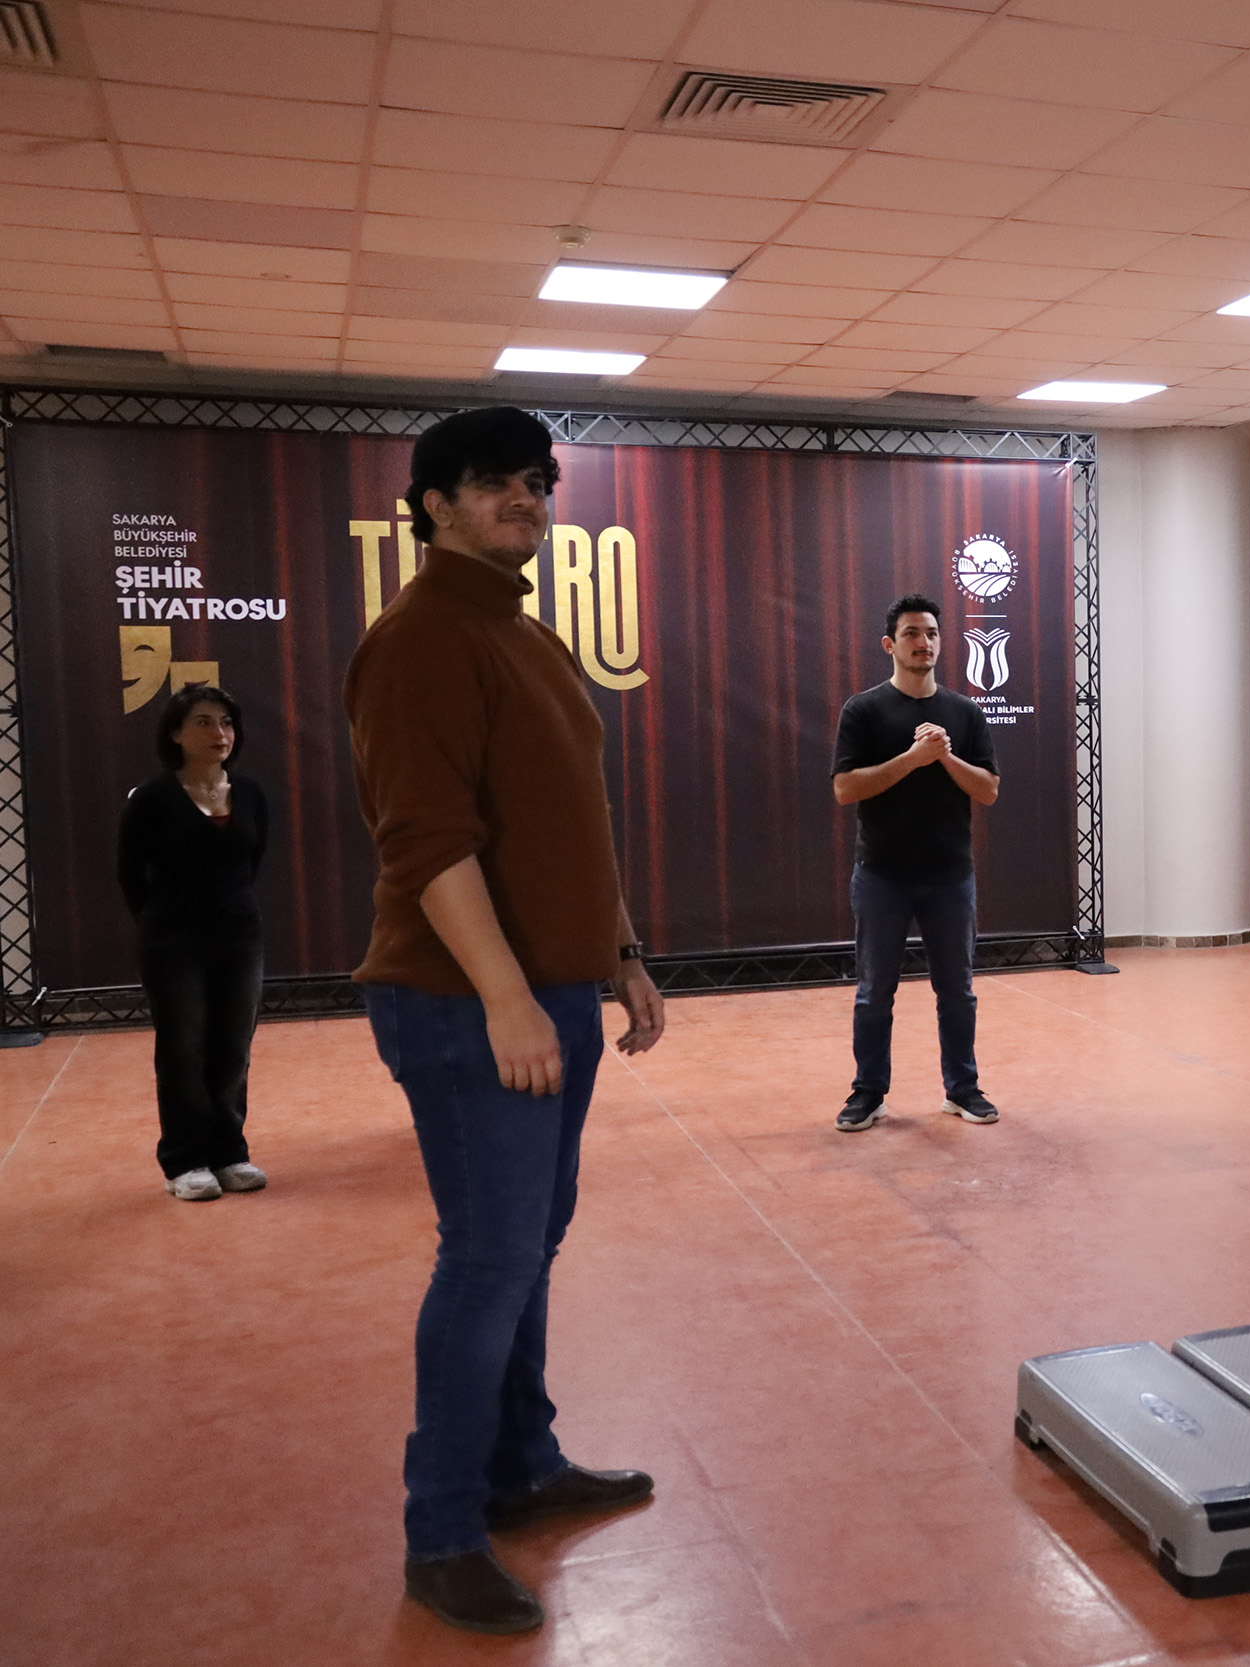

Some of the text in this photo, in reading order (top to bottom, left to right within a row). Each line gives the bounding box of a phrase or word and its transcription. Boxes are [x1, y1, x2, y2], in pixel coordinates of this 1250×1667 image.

[112, 513, 177, 526] SAKARYA
[113, 528, 197, 544] BÜYÜKŞEHİR
[963, 533, 1006, 547] SAKARYA
[114, 544, 187, 558] BELEDİYESİ
[115, 559, 204, 595] ŞEHİR
[117, 590, 287, 621] TİYATROSU
[997, 705, 1035, 714] BİLİMLER
[985, 716, 1017, 724] RSİTESİ
